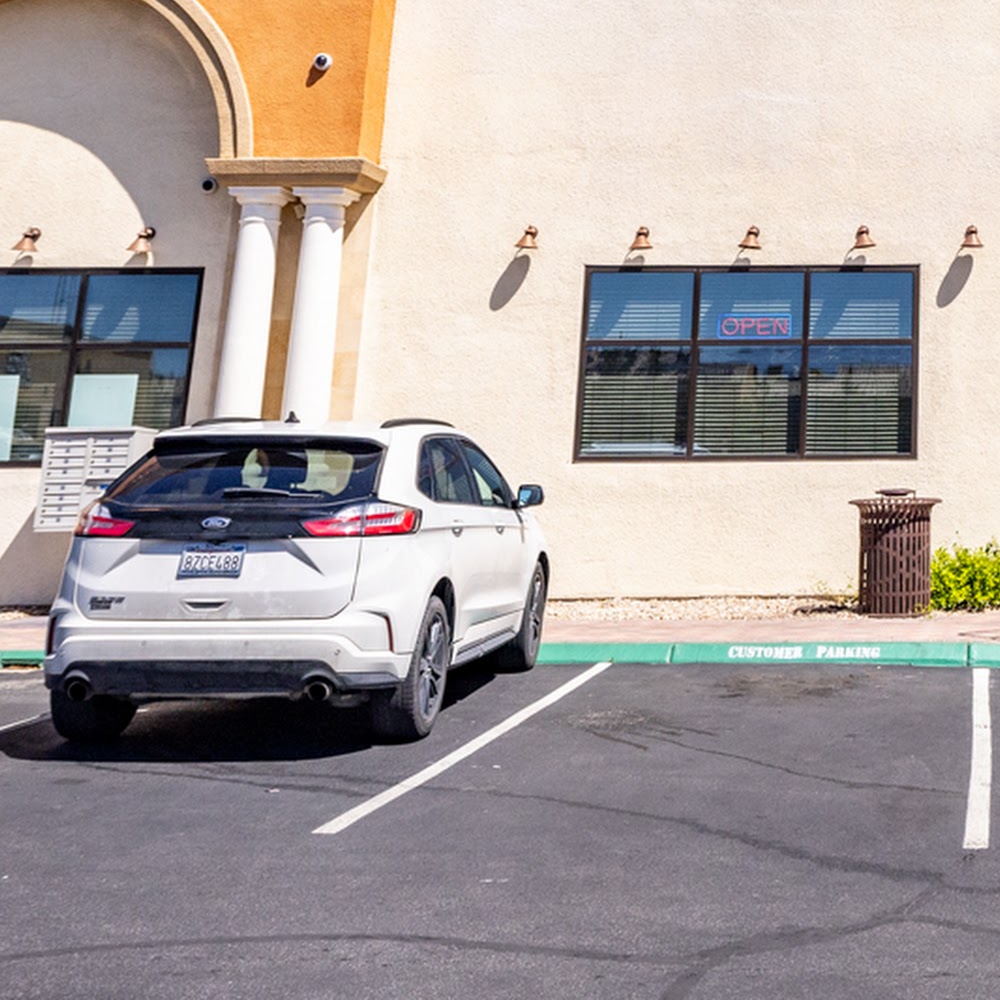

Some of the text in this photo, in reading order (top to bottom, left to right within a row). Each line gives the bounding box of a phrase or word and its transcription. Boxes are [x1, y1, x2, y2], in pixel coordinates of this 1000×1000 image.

[721, 317, 789, 336] OPEN
[728, 645, 881, 660] CUSTOMER PARKING
